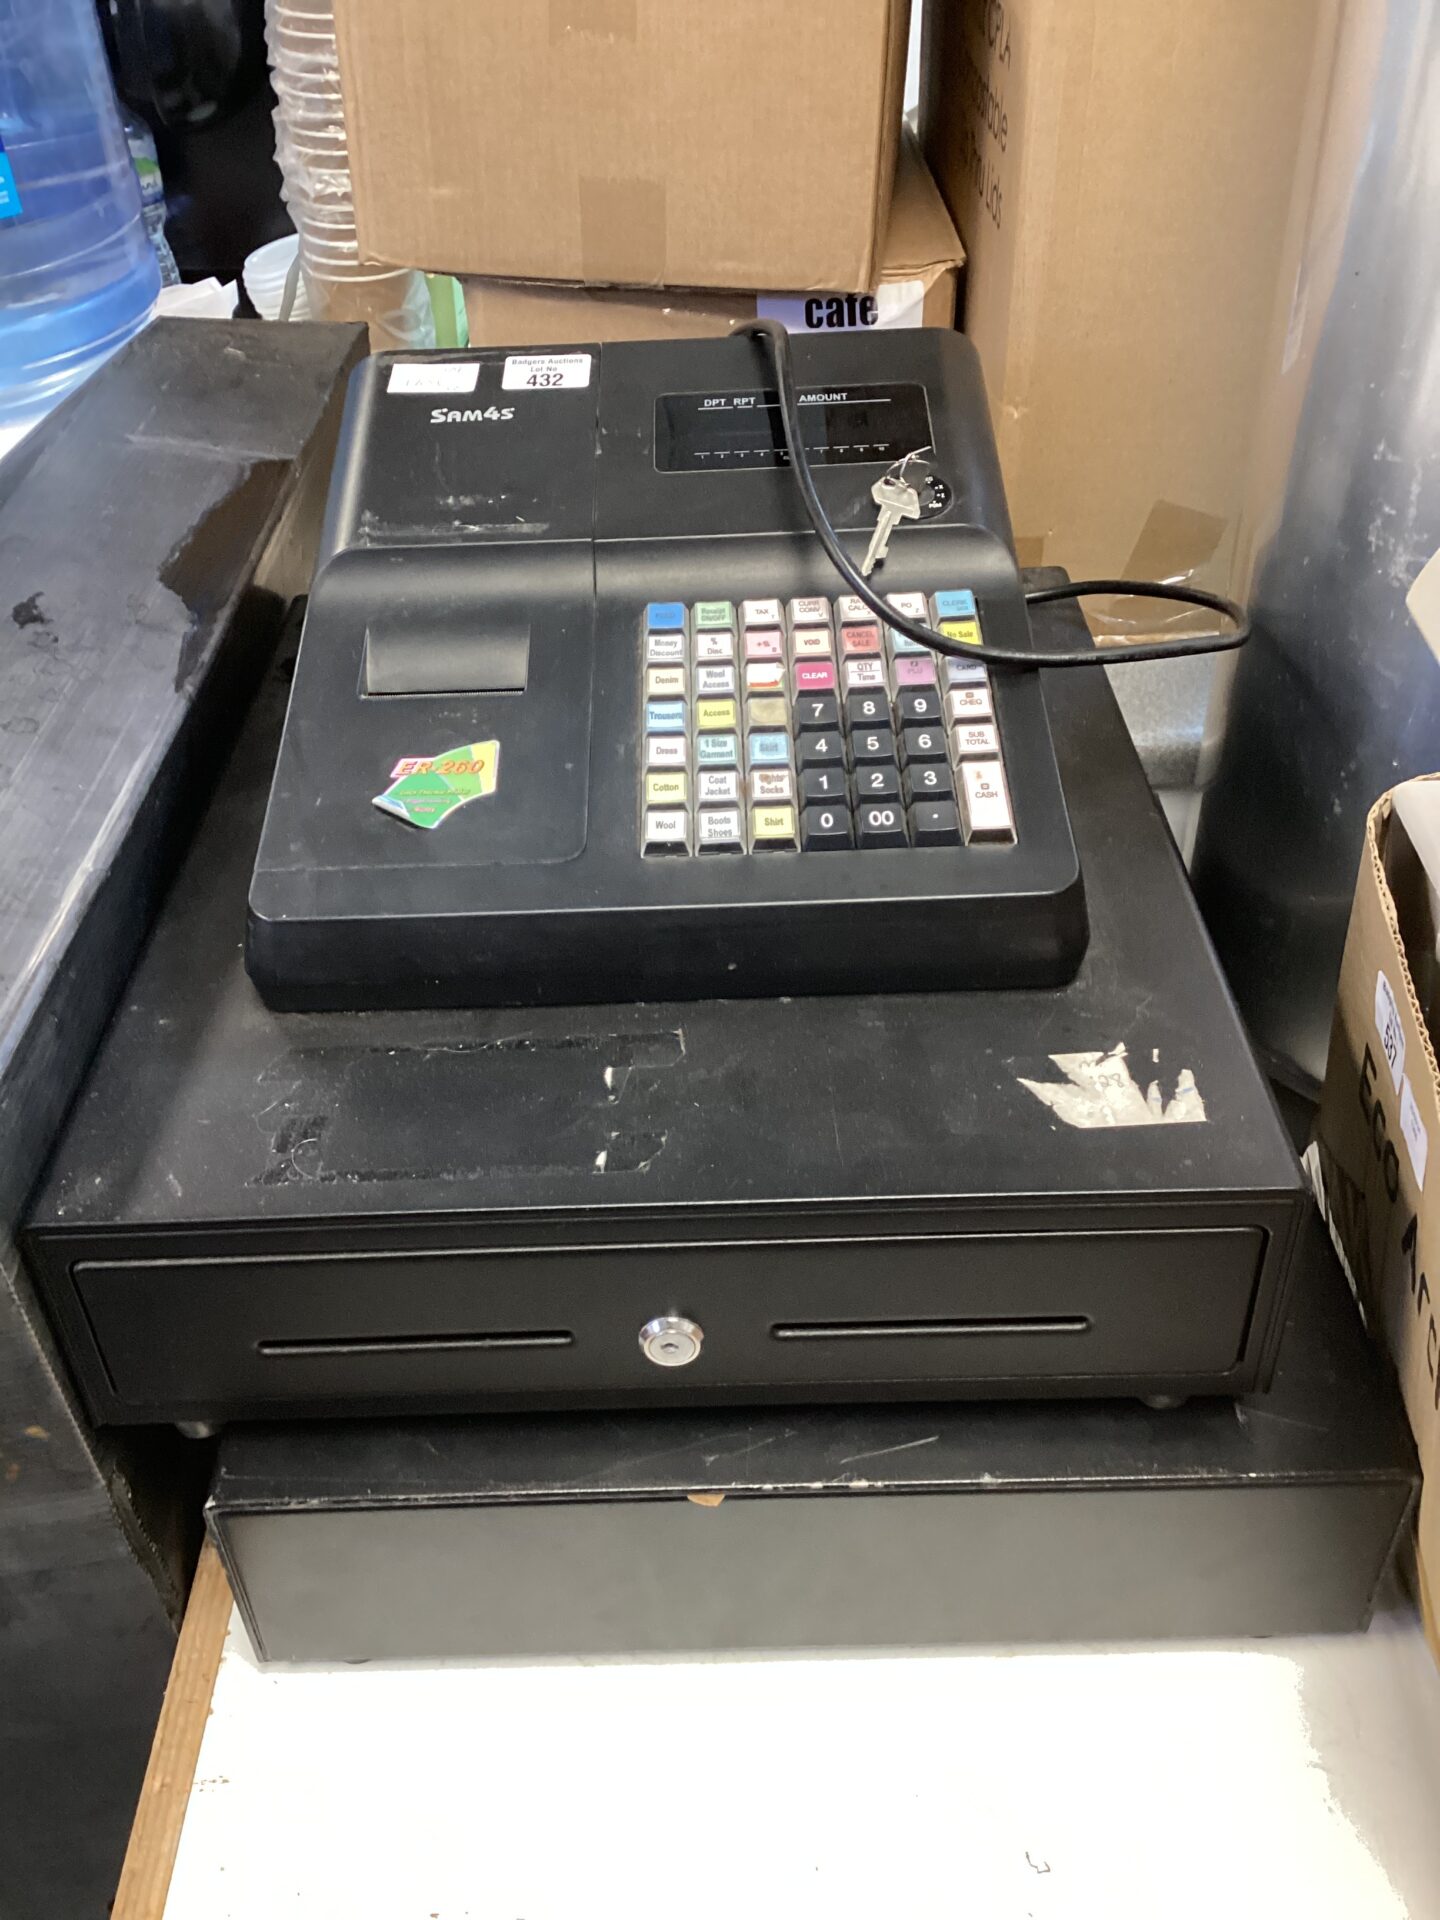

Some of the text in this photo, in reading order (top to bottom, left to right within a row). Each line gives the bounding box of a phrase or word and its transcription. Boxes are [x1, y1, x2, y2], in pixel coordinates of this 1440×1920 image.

[526, 373, 564, 387] 432
[704, 393, 848, 407] DPT RPT AMOUNT
[958, 630, 973, 638] Sale
[654, 639, 677, 648] Money
[707, 647, 723, 655] Disc
[857, 663, 873, 671] QTY
[706, 670, 725, 678] Wool
[857, 673, 876, 681] Time
[655, 676, 679, 684] Denim
[703, 681, 730, 689] Access
[812, 703, 824, 718] 7
[863, 701, 876, 715] 8
[914, 699, 927, 713] 9
[703, 709, 730, 717] Access
[815, 738, 828, 753] 4
[867, 736, 880, 751] 5
[918, 734, 932, 749] 6
[656, 747, 678, 755] Dress
[700, 751, 733, 759] Garment
[708, 776, 727, 784] Coat
[819, 775, 829, 790] 1
[871, 773, 884, 788] 2
[924, 771, 938, 785] 3
[653, 783, 679, 791] Cotton
[705, 787, 731, 796] Jacket
[760, 785, 784, 794] Socks
[975, 791, 998, 799] CASH
[708, 816, 731, 825] Boots
[764, 817, 784, 826] Shirt
[820, 813, 834, 828] 0
[868, 810, 895, 826] 00
[655, 820, 676, 829] Wool
[708, 829, 732, 837] Shoes
